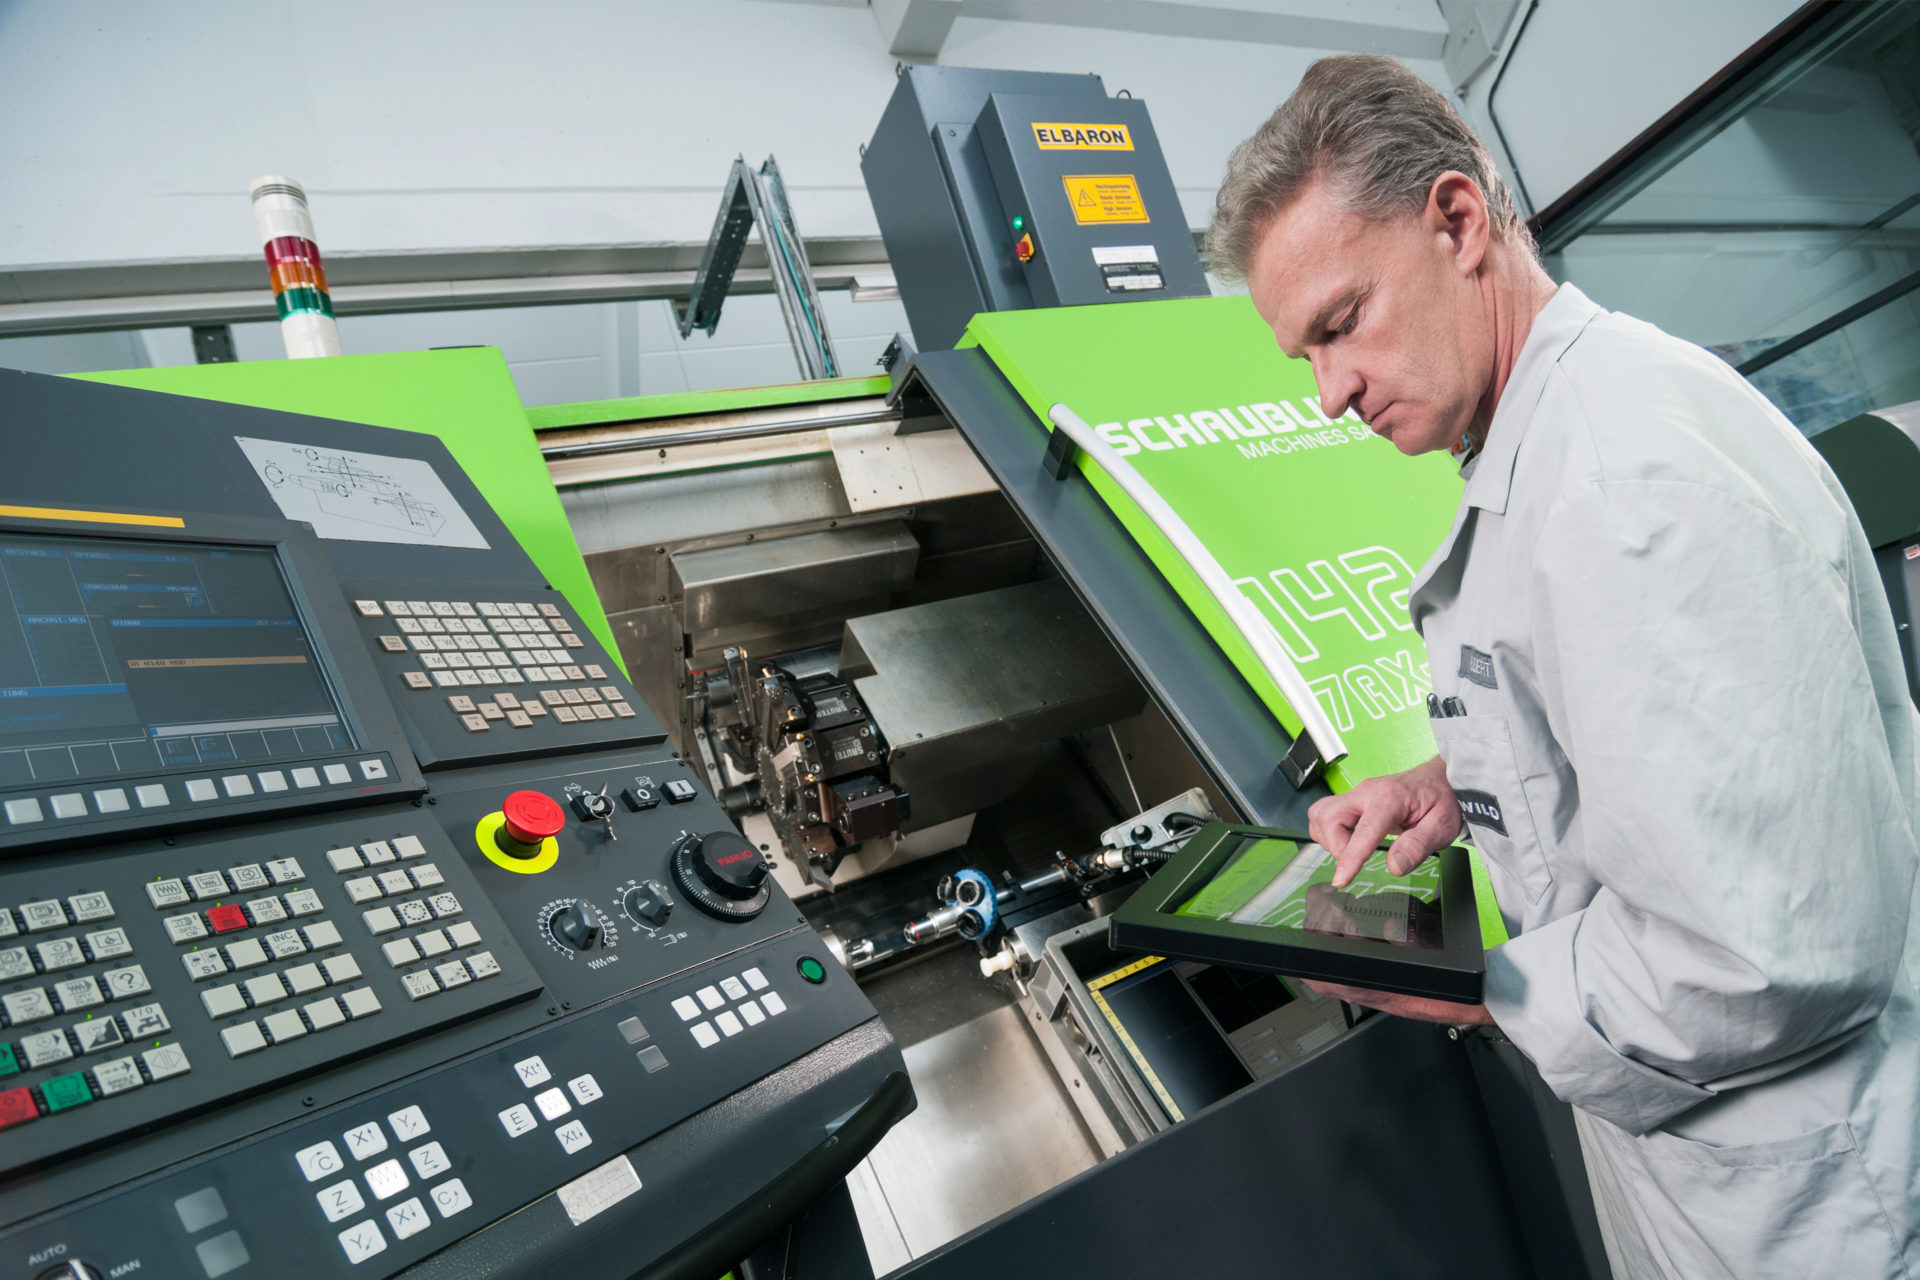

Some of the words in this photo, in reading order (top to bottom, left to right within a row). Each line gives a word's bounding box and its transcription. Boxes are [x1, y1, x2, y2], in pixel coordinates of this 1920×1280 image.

[1036, 128, 1126, 145] ELBARON
[1236, 428, 1350, 460] MACHINES
[1232, 545, 1416, 663] 142
[1305, 645, 1433, 733] 7AX
[1457, 799, 1500, 820] WILD
[717, 850, 754, 867] FANUC
[282, 870, 298, 880] S4
[302, 903, 316, 912] S1
[272, 932, 294, 943] INC
[202, 964, 218, 974] S1
[578, 1080, 590, 1094] E
[396, 1114, 408, 1128] Y
[510, 1111, 524, 1125] E
[352, 1130, 368, 1146] X
[318, 1156, 334, 1171] C
[420, 1150, 434, 1166] Z
[331, 1190, 348, 1207] Z
[438, 1190, 452, 1206] C
[394, 1208, 410, 1225] X
[350, 1234, 362, 1249] Y
[28, 1242, 68, 1266] AUTO
[110, 1258, 142, 1279] MAN
